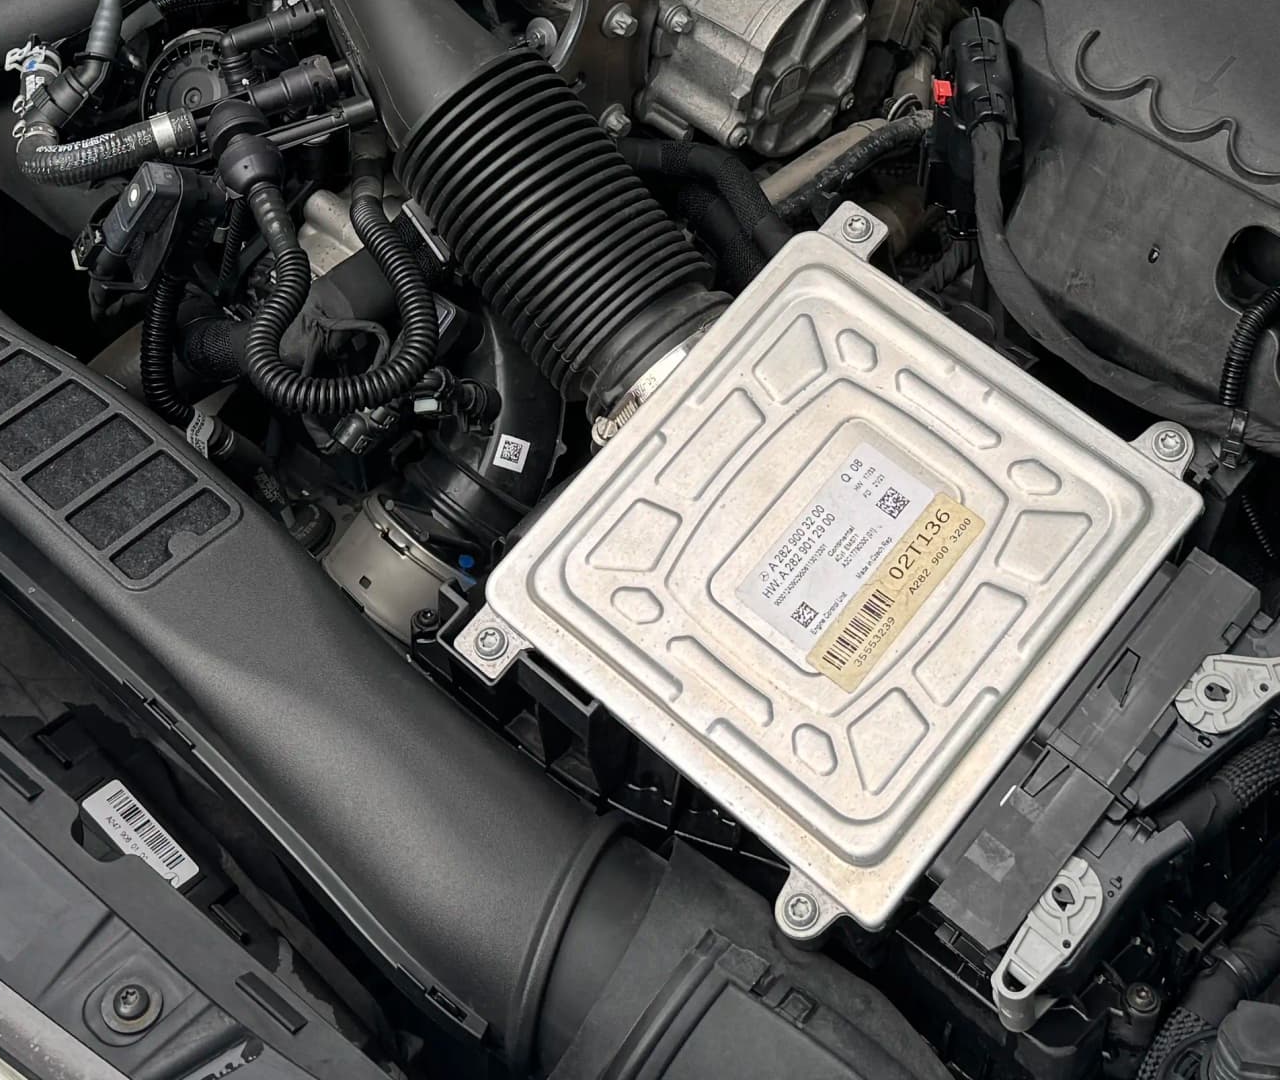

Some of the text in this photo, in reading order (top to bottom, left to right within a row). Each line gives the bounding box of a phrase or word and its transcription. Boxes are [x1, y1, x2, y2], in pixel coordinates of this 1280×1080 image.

[839, 457, 863, 484] Q 08
[766, 502, 825, 572] A 282 900 32 00
[777, 568, 789, 580] A
[784, 552, 802, 572] 282
[797, 535, 816, 555] 901
[811, 523, 826, 539] 29
[820, 511, 836, 527] 00
[827, 524, 855, 558] Continental
[855, 564, 869, 579] Made
[869, 545, 884, 562] Czech
[887, 506, 952, 582] 02T136
[907, 517, 971, 595] A282 900 3200
[810, 591, 848, 636] Engine Control Unit
[852, 615, 896, 668] 35553239
